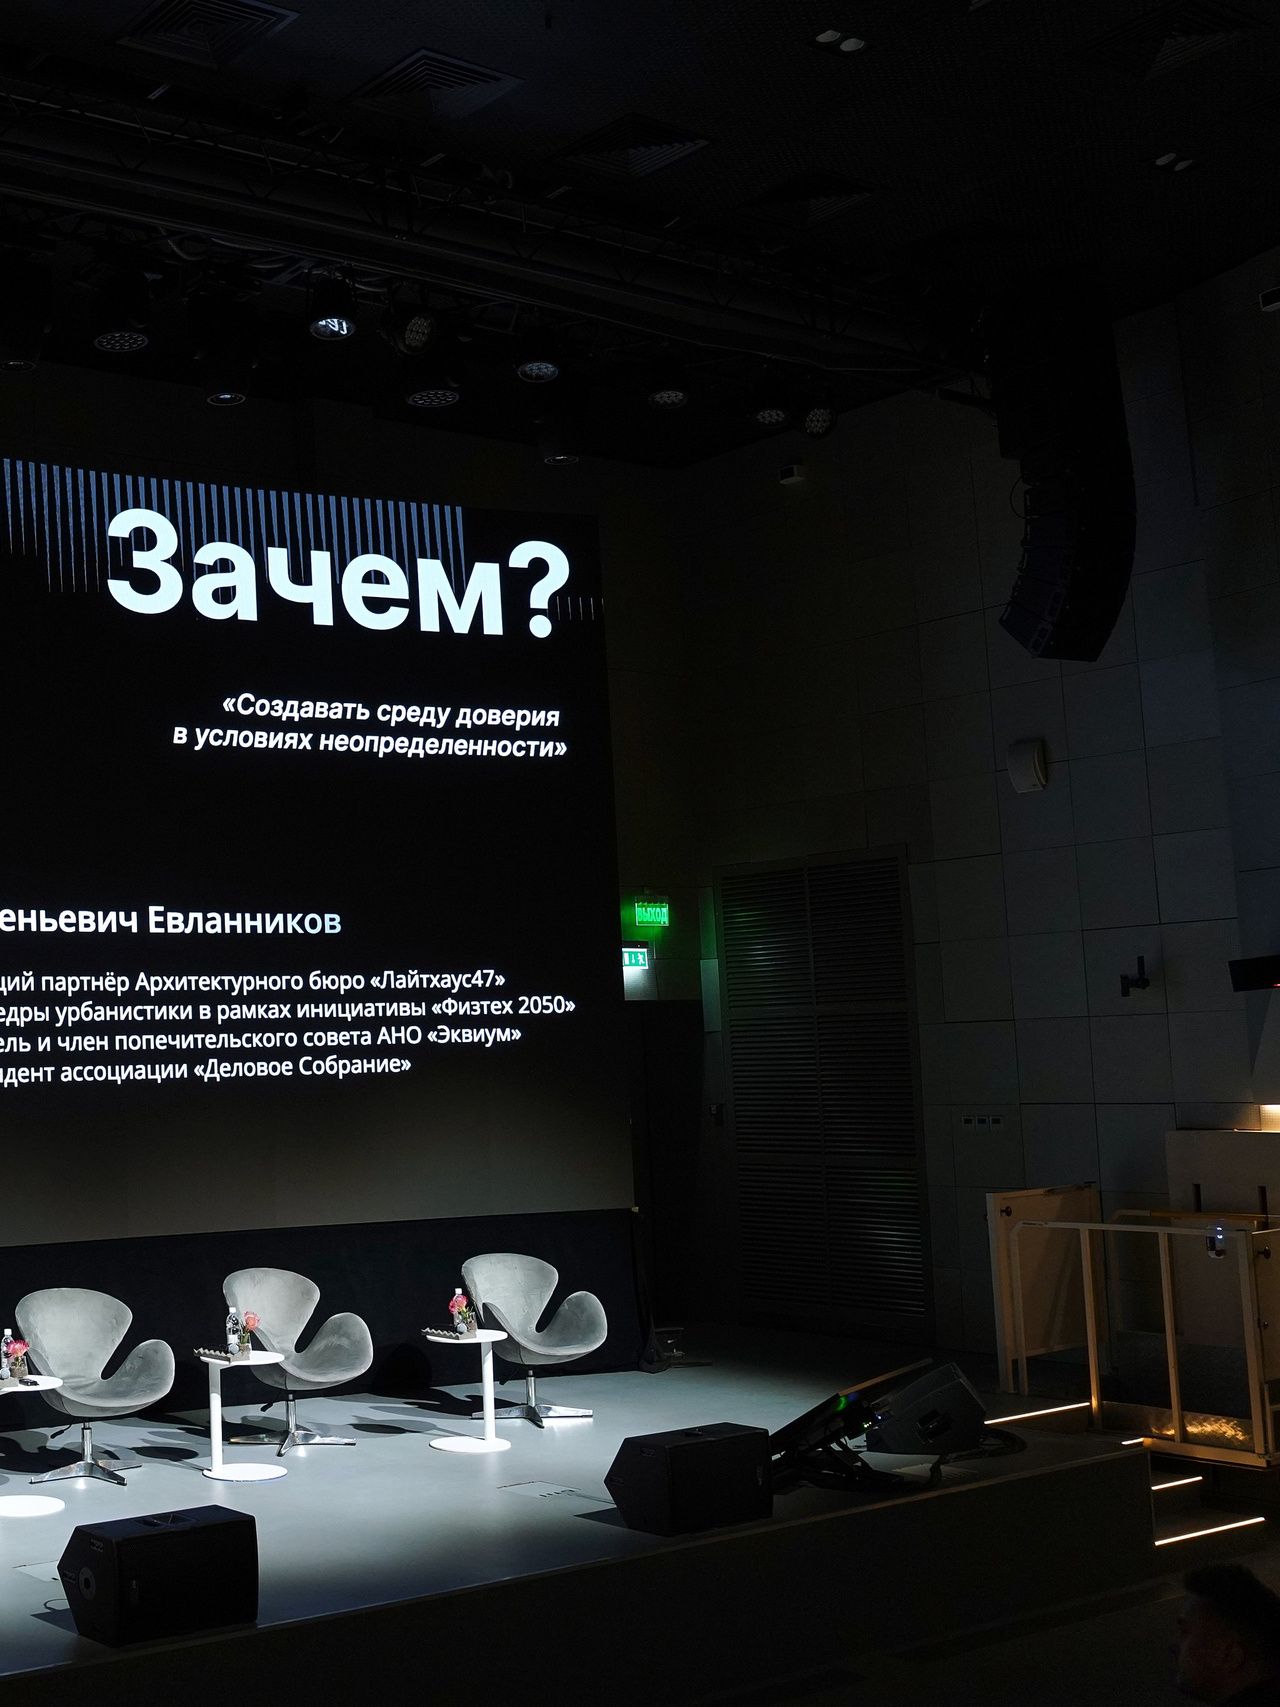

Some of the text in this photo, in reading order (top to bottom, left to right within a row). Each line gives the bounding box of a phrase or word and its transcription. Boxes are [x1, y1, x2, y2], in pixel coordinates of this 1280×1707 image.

[107, 508, 570, 638] Зачем?
[222, 692, 560, 732] «Создавать среду доверия
[172, 726, 568, 759] в условиях неопределенности»
[148, 905, 342, 935] Евланников
[637, 907, 668, 925] ВЫХОД
[41, 971, 130, 997] партнёр
[134, 971, 304, 997] Архитектурного
[308, 969, 365, 995] бюро
[369, 969, 506, 994] «Лайтхаус47»
[54, 1000, 193, 1028] урбанистики
[198, 1004, 212, 1020] в
[217, 1003, 292, 1025] рамках
[296, 1001, 426, 1022] инициативы
[431, 997, 514, 1016] «Физтех
[518, 995, 576, 1015] 2050»
[37, 1036, 51, 1052] и
[57, 1035, 109, 1052] член
[115, 1032, 298, 1051] попечительского
[302, 1030, 372, 1047] совета
[376, 1025, 423, 1045] АНО
[426, 1024, 522, 1048] «Эквиум»
[60, 1063, 188, 1085] ассоциации
[193, 1058, 294, 1083] «Деловое
[298, 1054, 412, 1080] Собрание»
